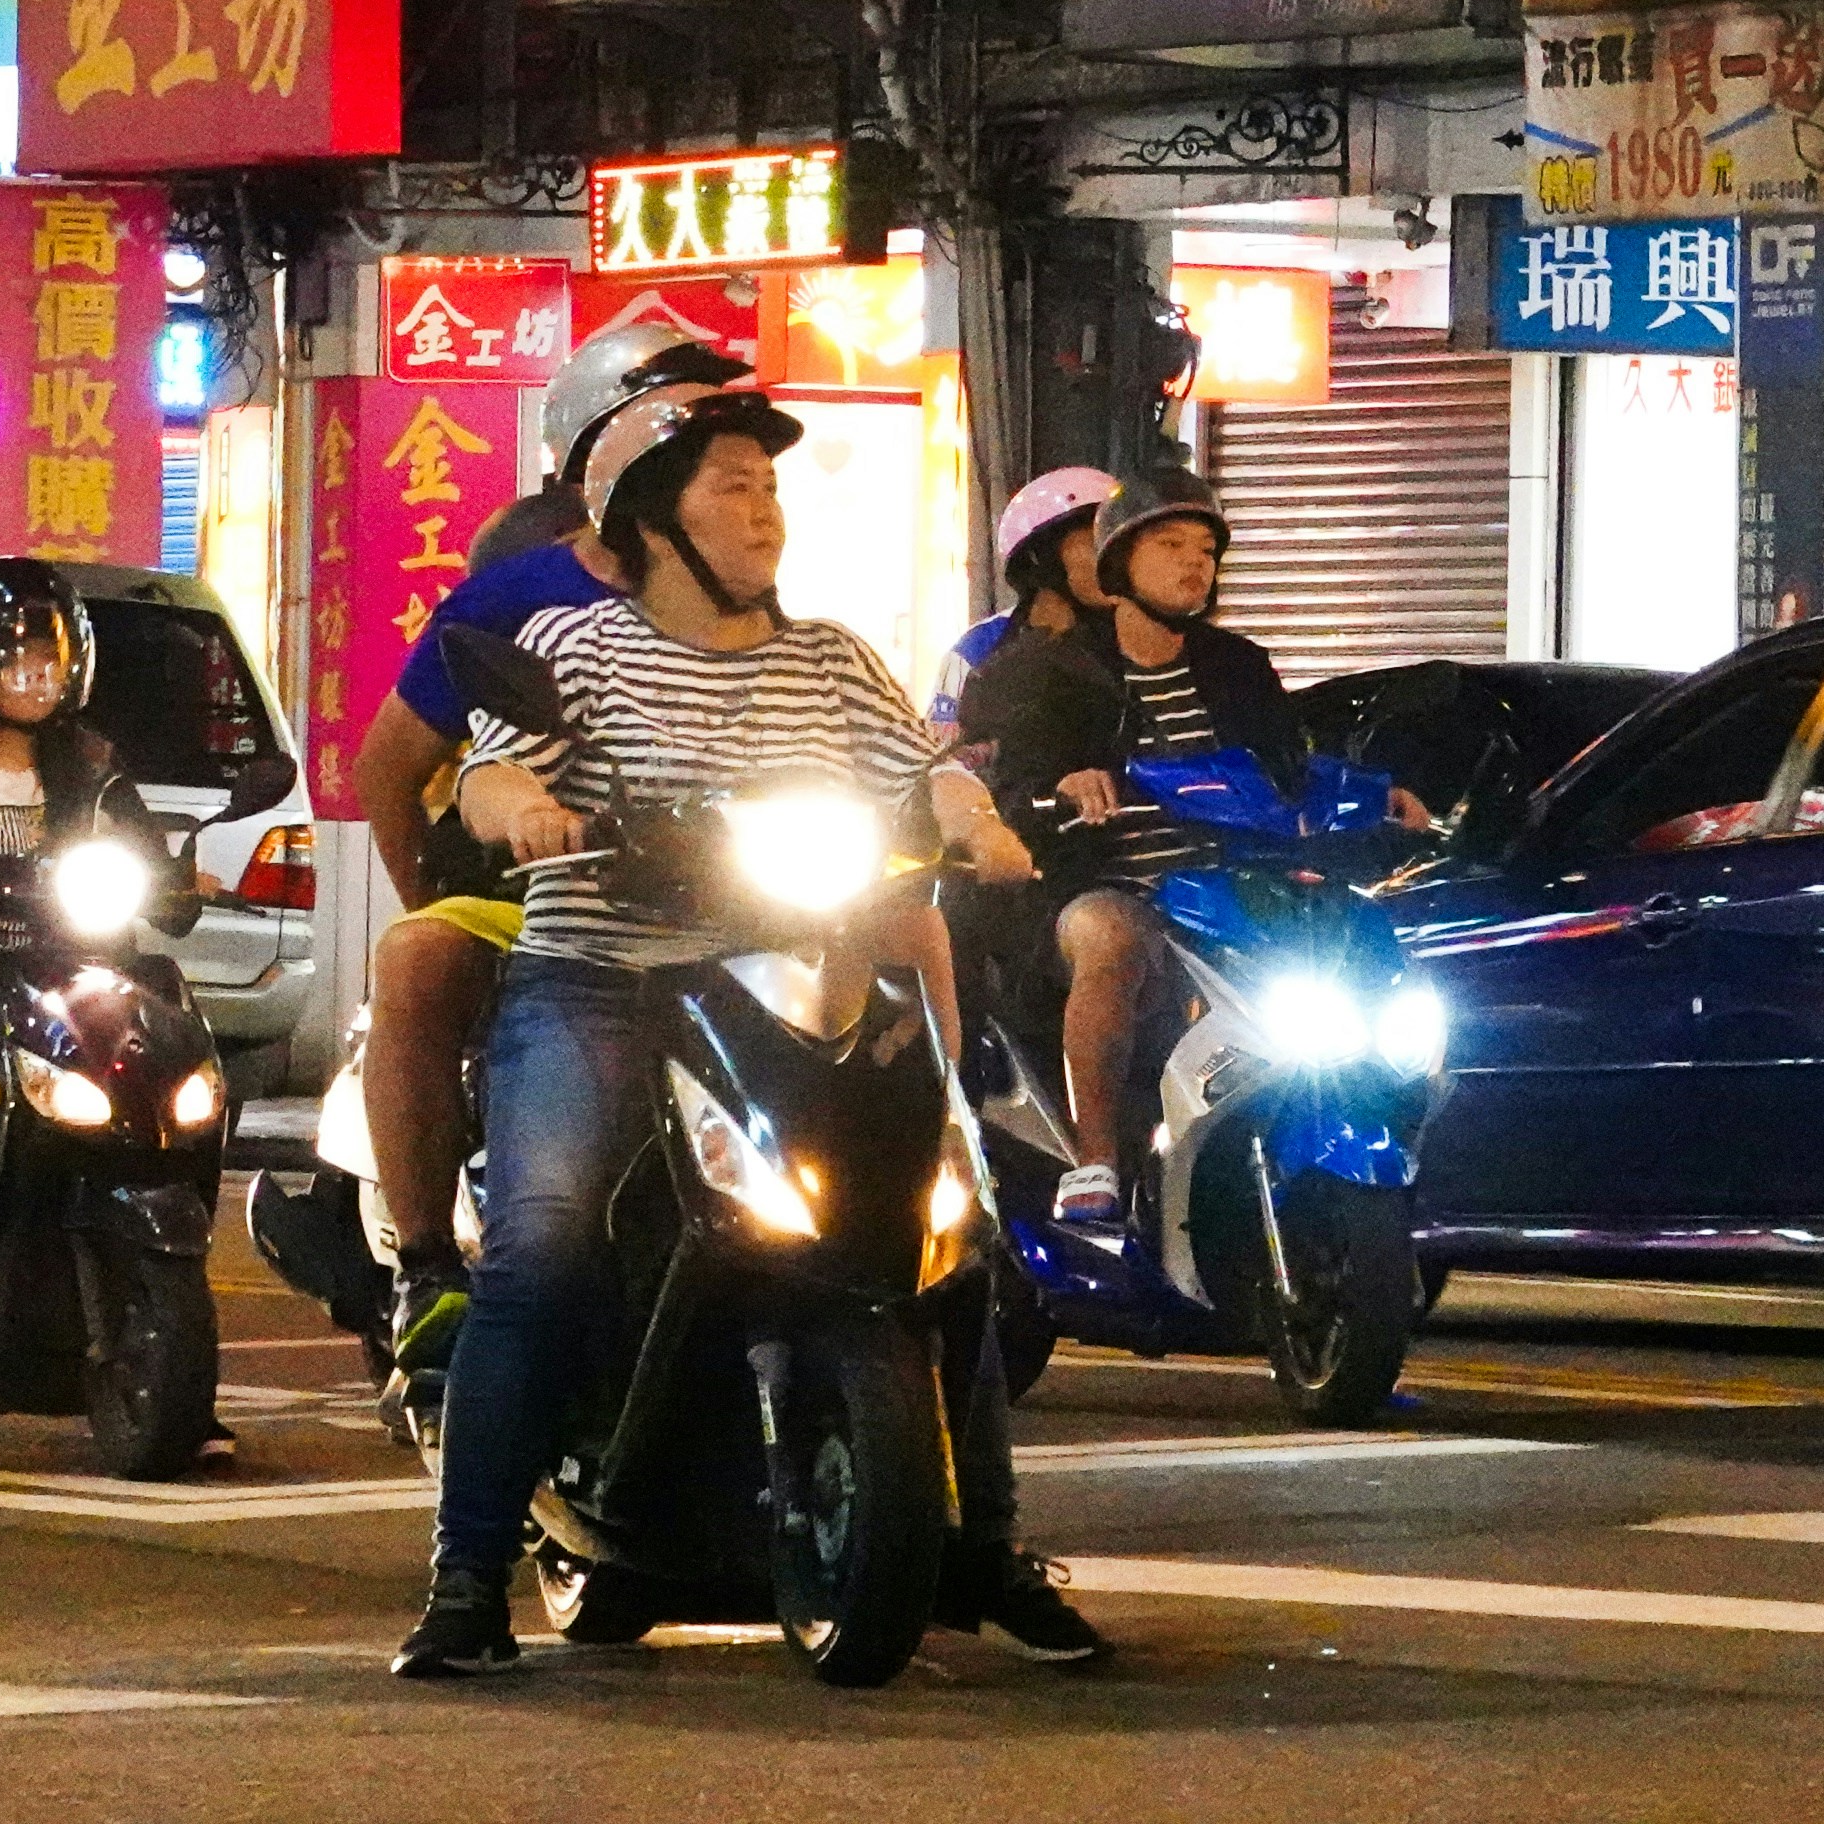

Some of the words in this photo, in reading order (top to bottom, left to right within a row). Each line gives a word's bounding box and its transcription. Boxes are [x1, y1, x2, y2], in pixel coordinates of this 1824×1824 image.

[395, 283, 559, 369] 金工坊
[1518, 225, 1737, 335] 瑞興
